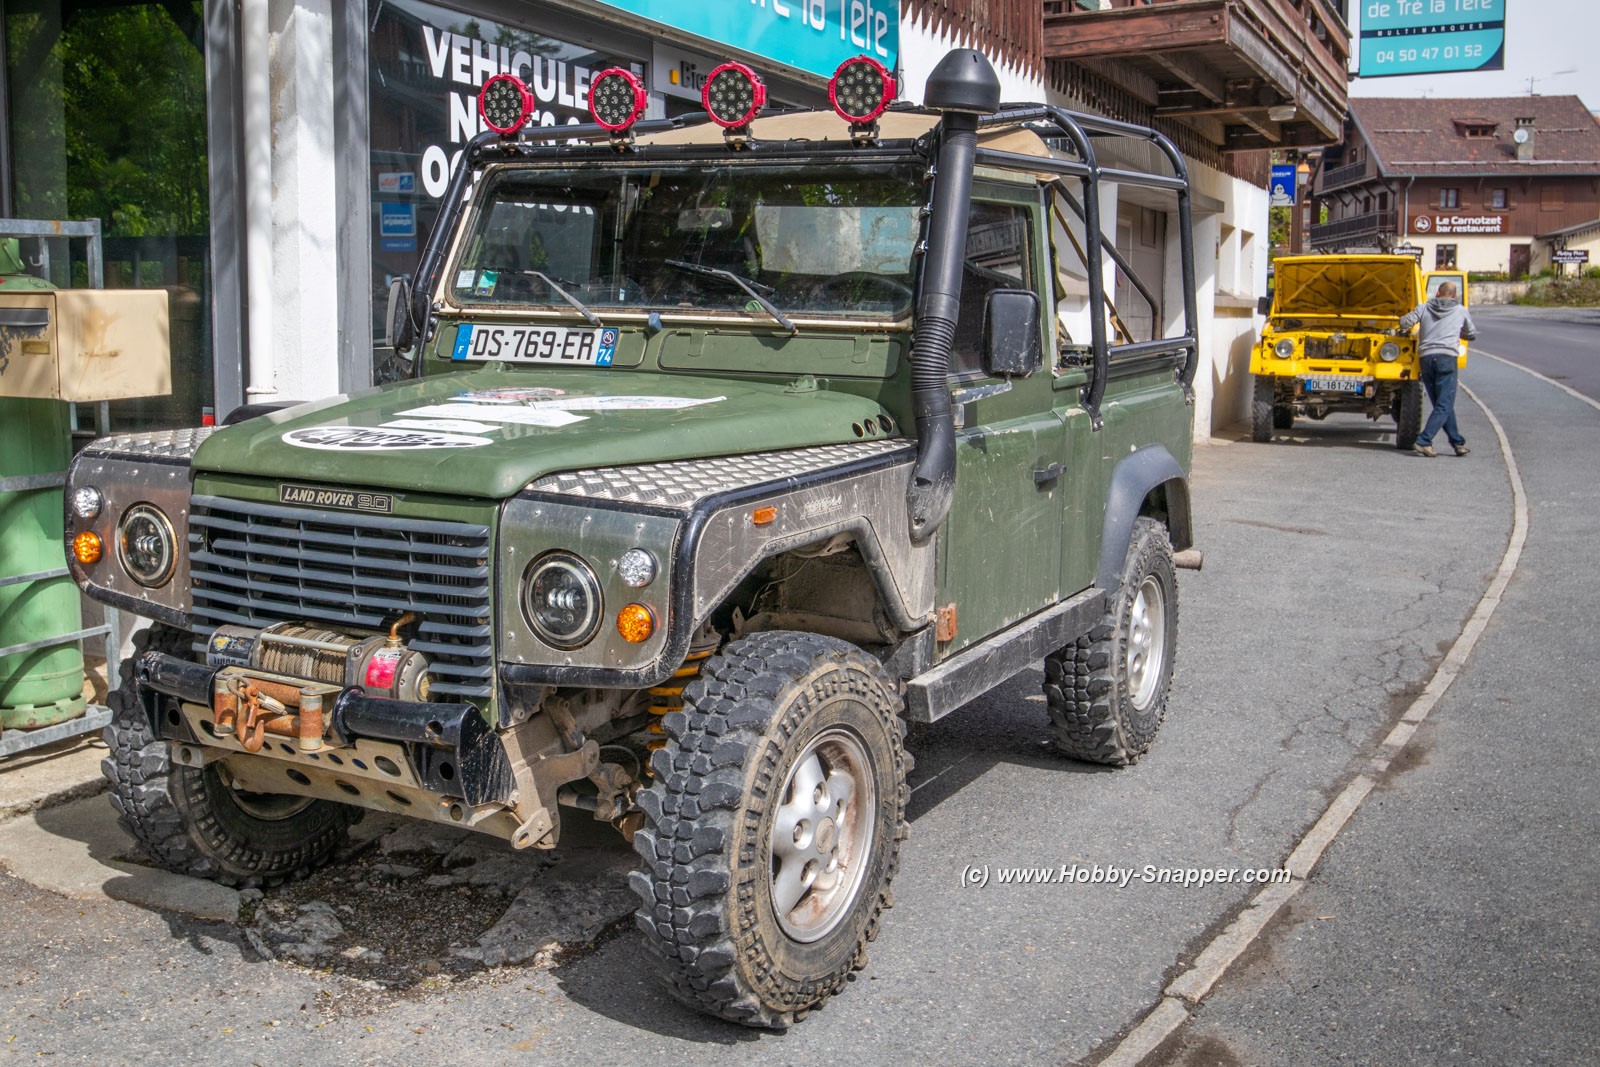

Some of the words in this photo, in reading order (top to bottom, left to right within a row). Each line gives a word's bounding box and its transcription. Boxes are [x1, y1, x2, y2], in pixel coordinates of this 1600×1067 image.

[1368, 2, 1390, 18] de
[1430, 0, 1446, 13] la
[1377, 23, 1484, 37] MULTIMARQUES
[1376, 51, 1394, 63] 04
[1399, 49, 1417, 62] 50
[1421, 48, 1439, 60] 47
[1444, 46, 1460, 58] 01
[1464, 44, 1483, 57] 52
[422, 25, 602, 112] VEHICULE
[681, 60, 707, 92] Bie
[1435, 215, 1450, 225] Le
[1451, 215, 1502, 225] Carnotzet
[1436, 225, 1451, 233] bar
[1452, 225, 1501, 233] restaurant
[457, 345, 465, 354] F
[472, 329, 596, 361] DS-769-ER
[598, 349, 612, 363] 74
[1312, 381, 1356, 391] DL-181-ZH
[284, 488, 316, 504] LAND
[316, 491, 355, 507] ROVER
[358, 494, 389, 512] 90
